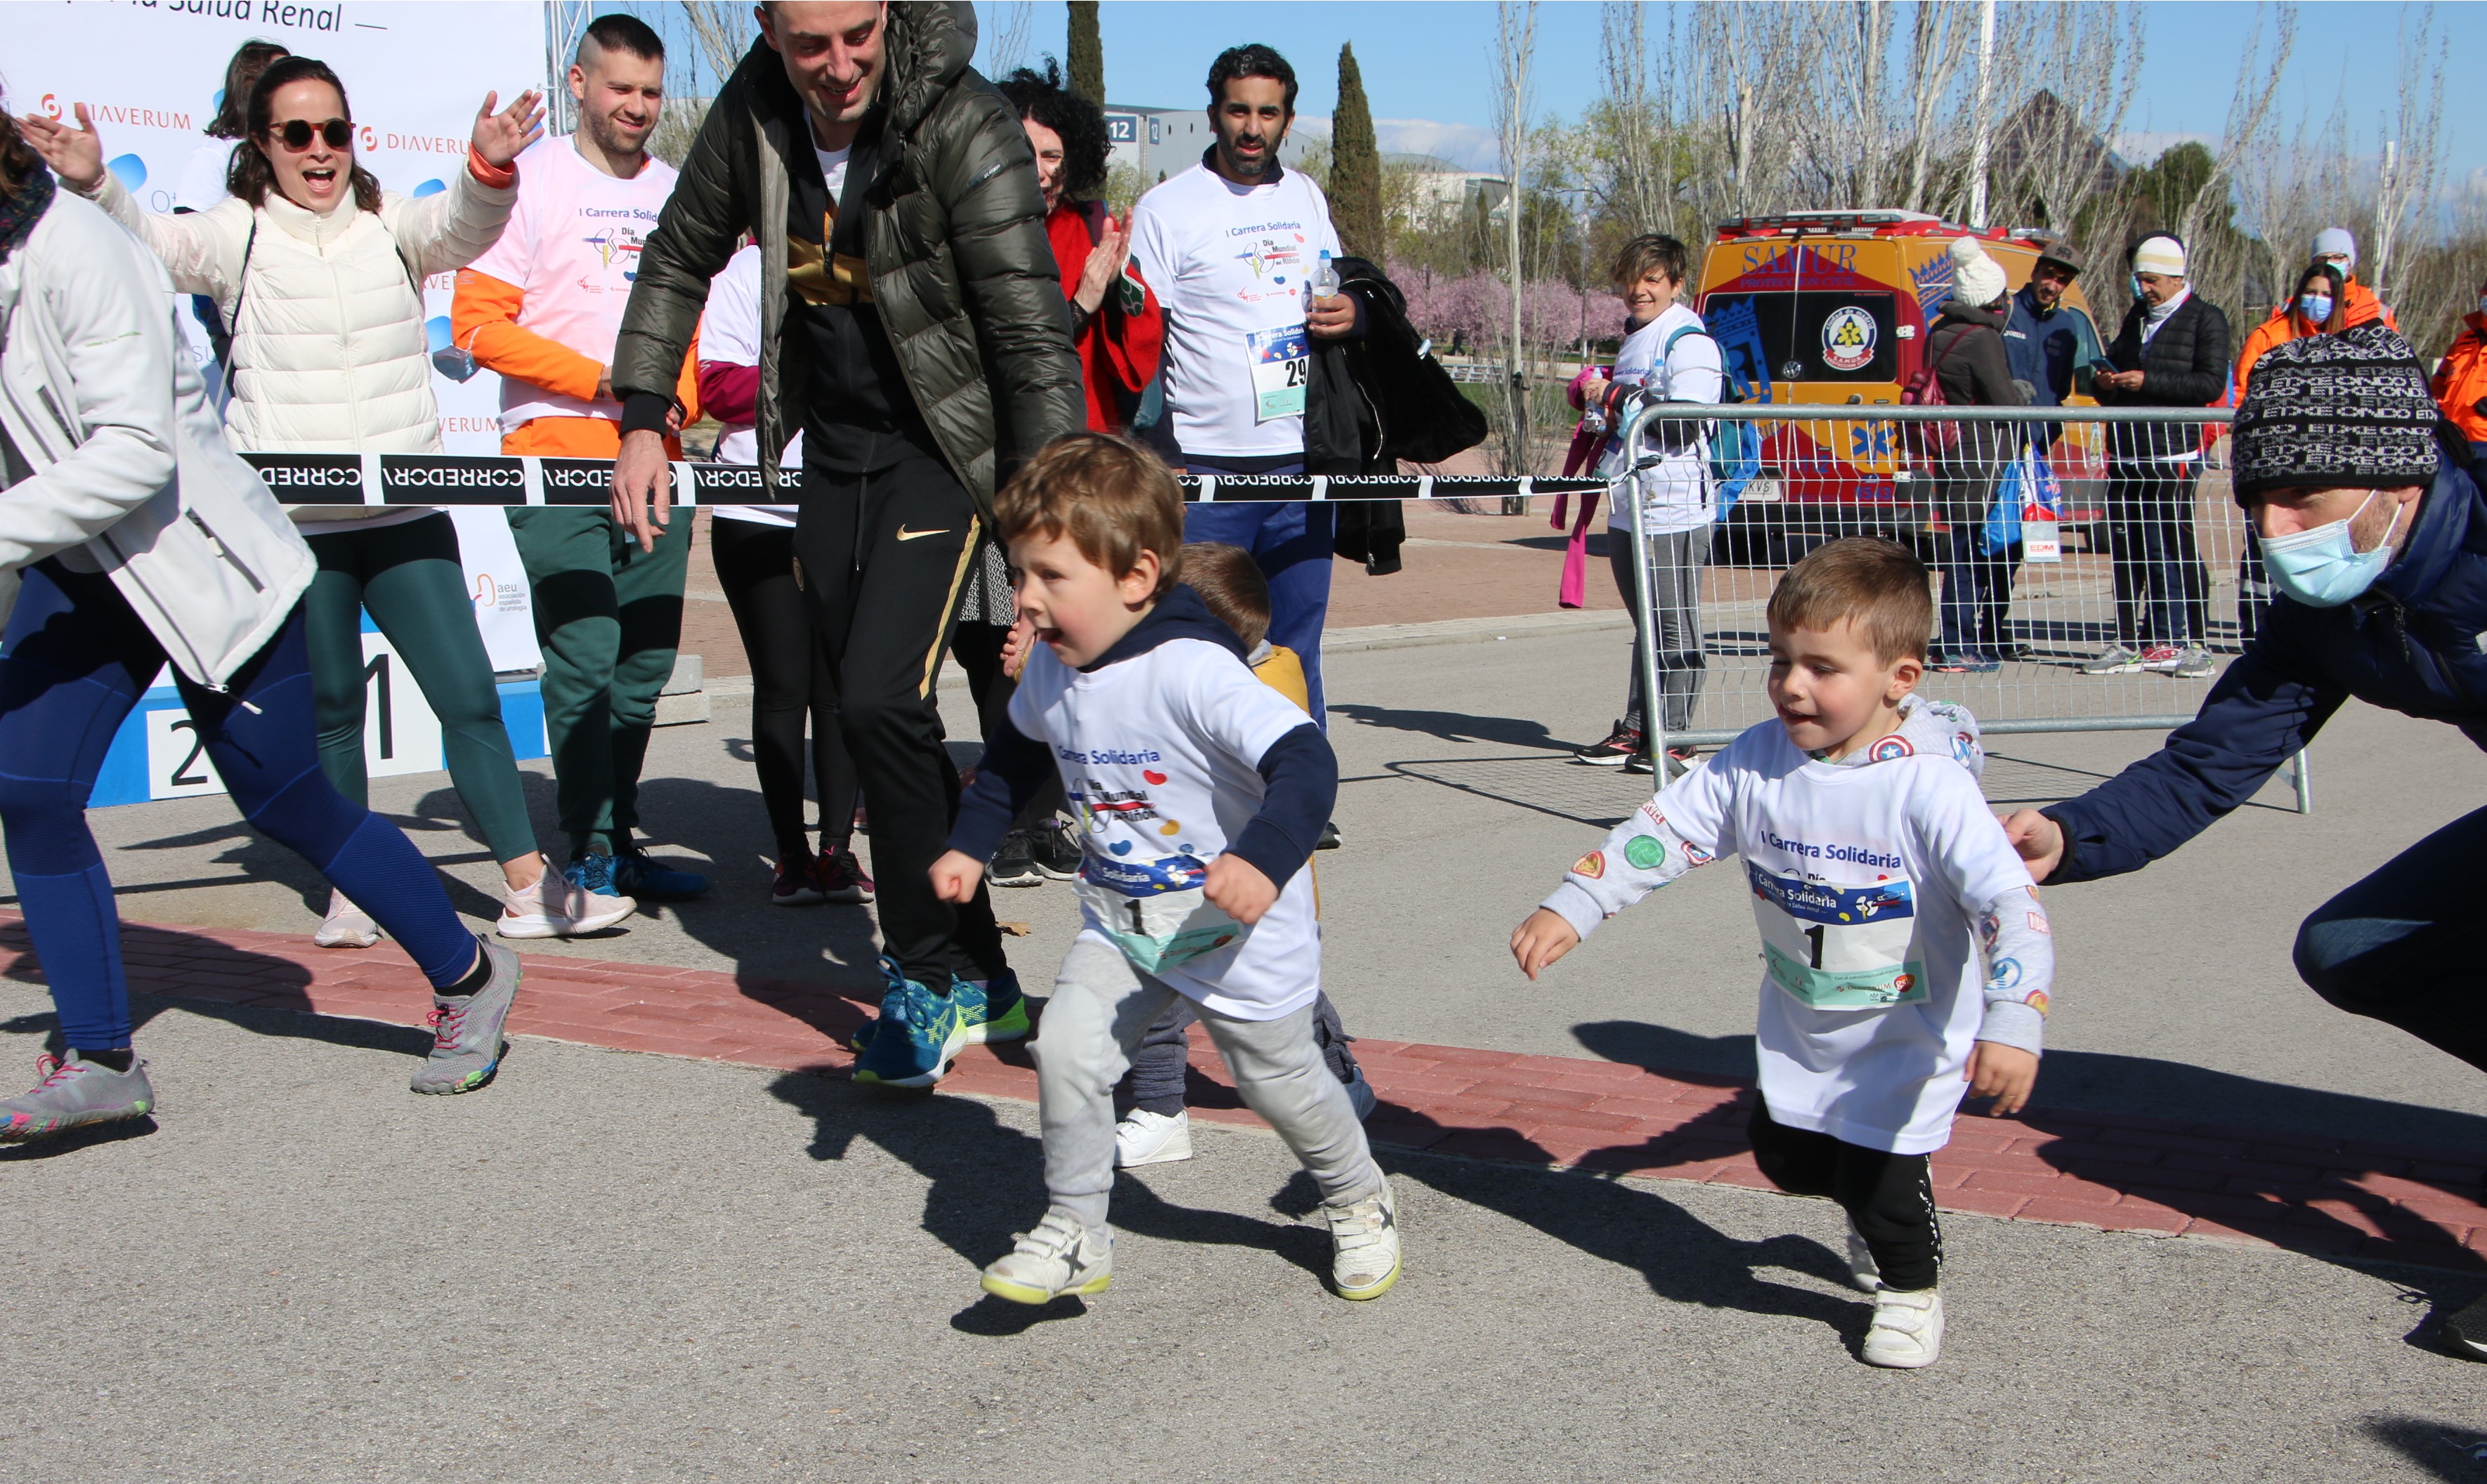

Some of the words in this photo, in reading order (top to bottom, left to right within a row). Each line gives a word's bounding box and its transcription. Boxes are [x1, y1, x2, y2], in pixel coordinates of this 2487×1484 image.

[262, 1, 342, 32] Renal
[1110, 122, 1130, 138] 12
[1151, 124, 1158, 140] 12
[387, 133, 471, 155] DIAVERU
[586, 208, 630, 218] Carrera
[633, 209, 658, 223] Solid
[1232, 224, 1266, 237] Carrera
[1267, 221, 1301, 231] Solidaria
[1272, 245, 1298, 254] Mundial
[1742, 244, 1857, 275] SAMUR
[1822, 276, 1856, 287] CIVIL
[1285, 358, 1307, 387] 29
[258, 466, 363, 487] CORRED
[1748, 480, 1770, 492] KVS
[497, 584, 518, 593] aeu
[364, 653, 393, 759] 1
[171, 719, 208, 787] 2
[1091, 749, 1161, 764] Solidaria
[1769, 832, 1821, 858] Carrera
[1825, 844, 1902, 869] Solidaria
[1102, 865, 1151, 883] Solidaria
[1787, 888, 1837, 909] Solidaria
[1124, 899, 1146, 935] 1
[1804, 924, 1825, 970] 1
[1895, 977, 1912, 990] gsk
